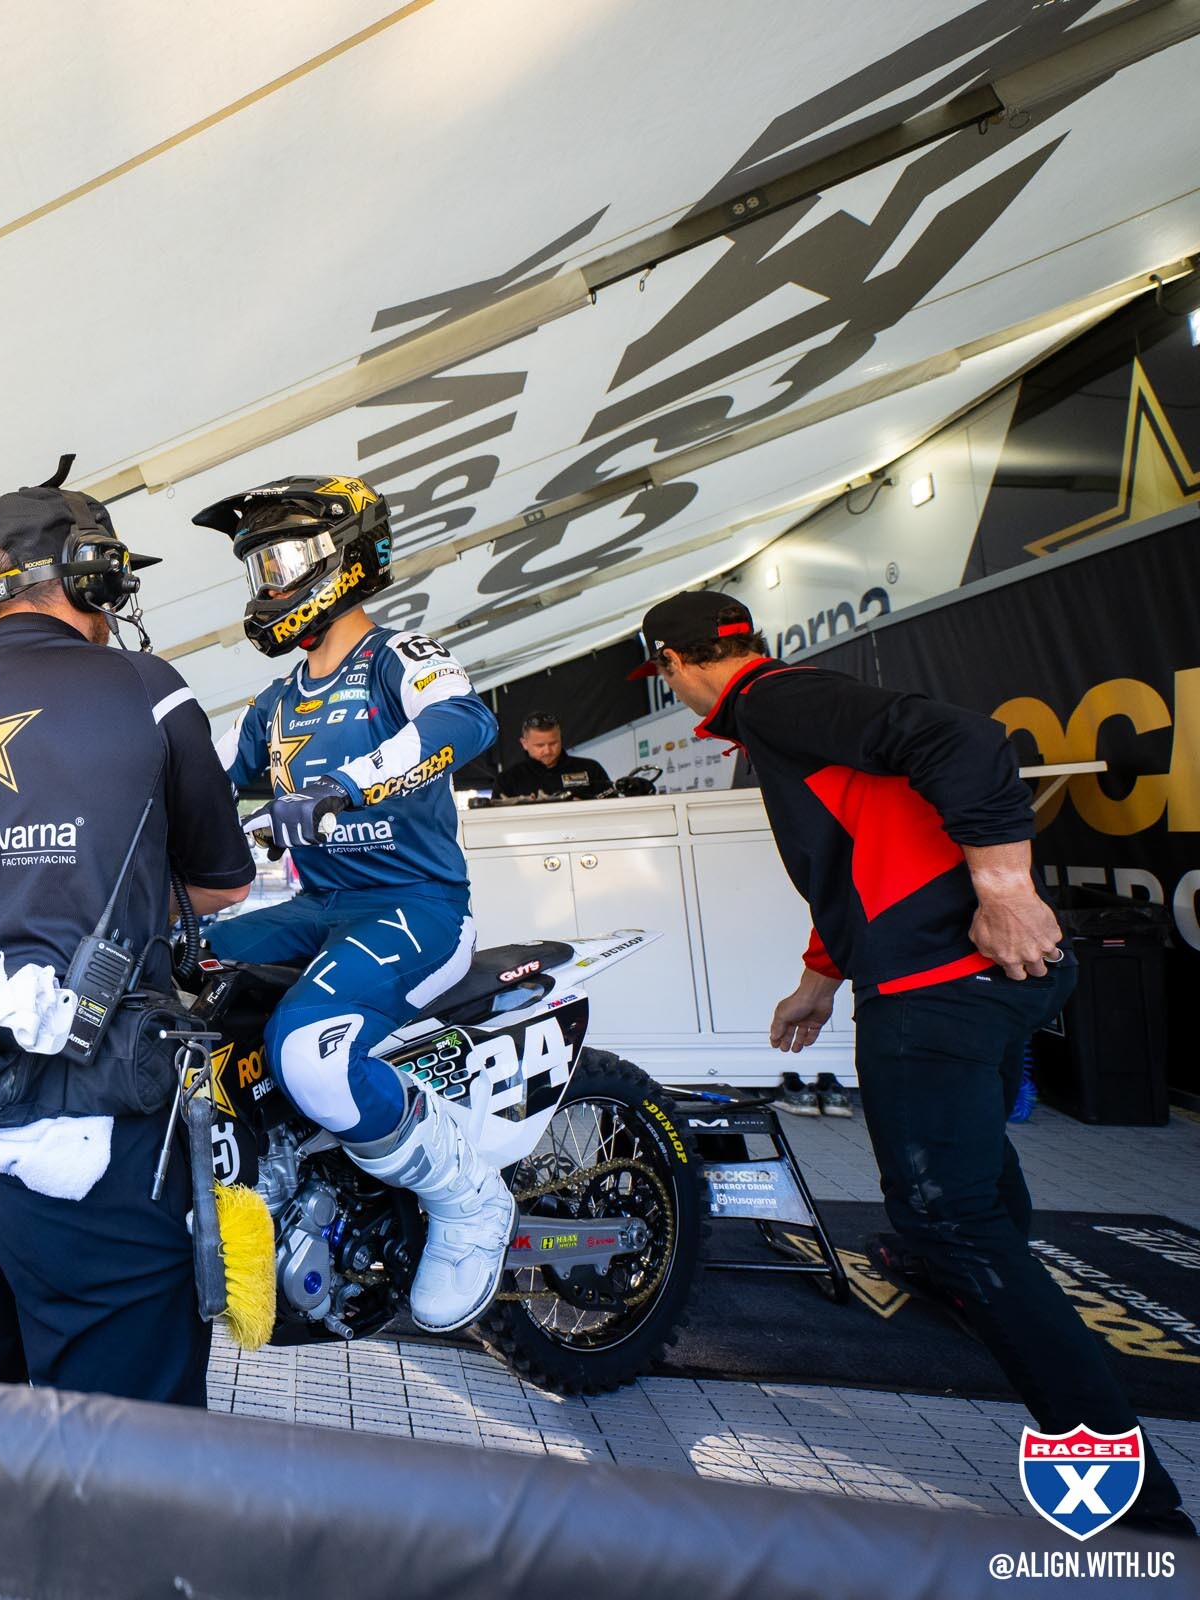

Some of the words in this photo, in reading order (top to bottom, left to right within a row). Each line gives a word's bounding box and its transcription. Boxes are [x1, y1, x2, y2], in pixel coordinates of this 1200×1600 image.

[272, 562, 365, 643] ROCKSTAR
[2, 857, 38, 867] FACTORY
[39, 855, 76, 865] RACING
[600, 936, 644, 958] DUNLOP
[499, 960, 541, 982] GUTS
[237, 1050, 264, 1089] RO
[466, 1016, 573, 1114] 24
[646, 1103, 688, 1164] DUNLOP
[704, 1170, 778, 1183] ROCKSTAR
[713, 1183, 746, 1191] ENERGY
[747, 1183, 775, 1191] DRINK
[728, 1195, 777, 1206] Husqvarna
